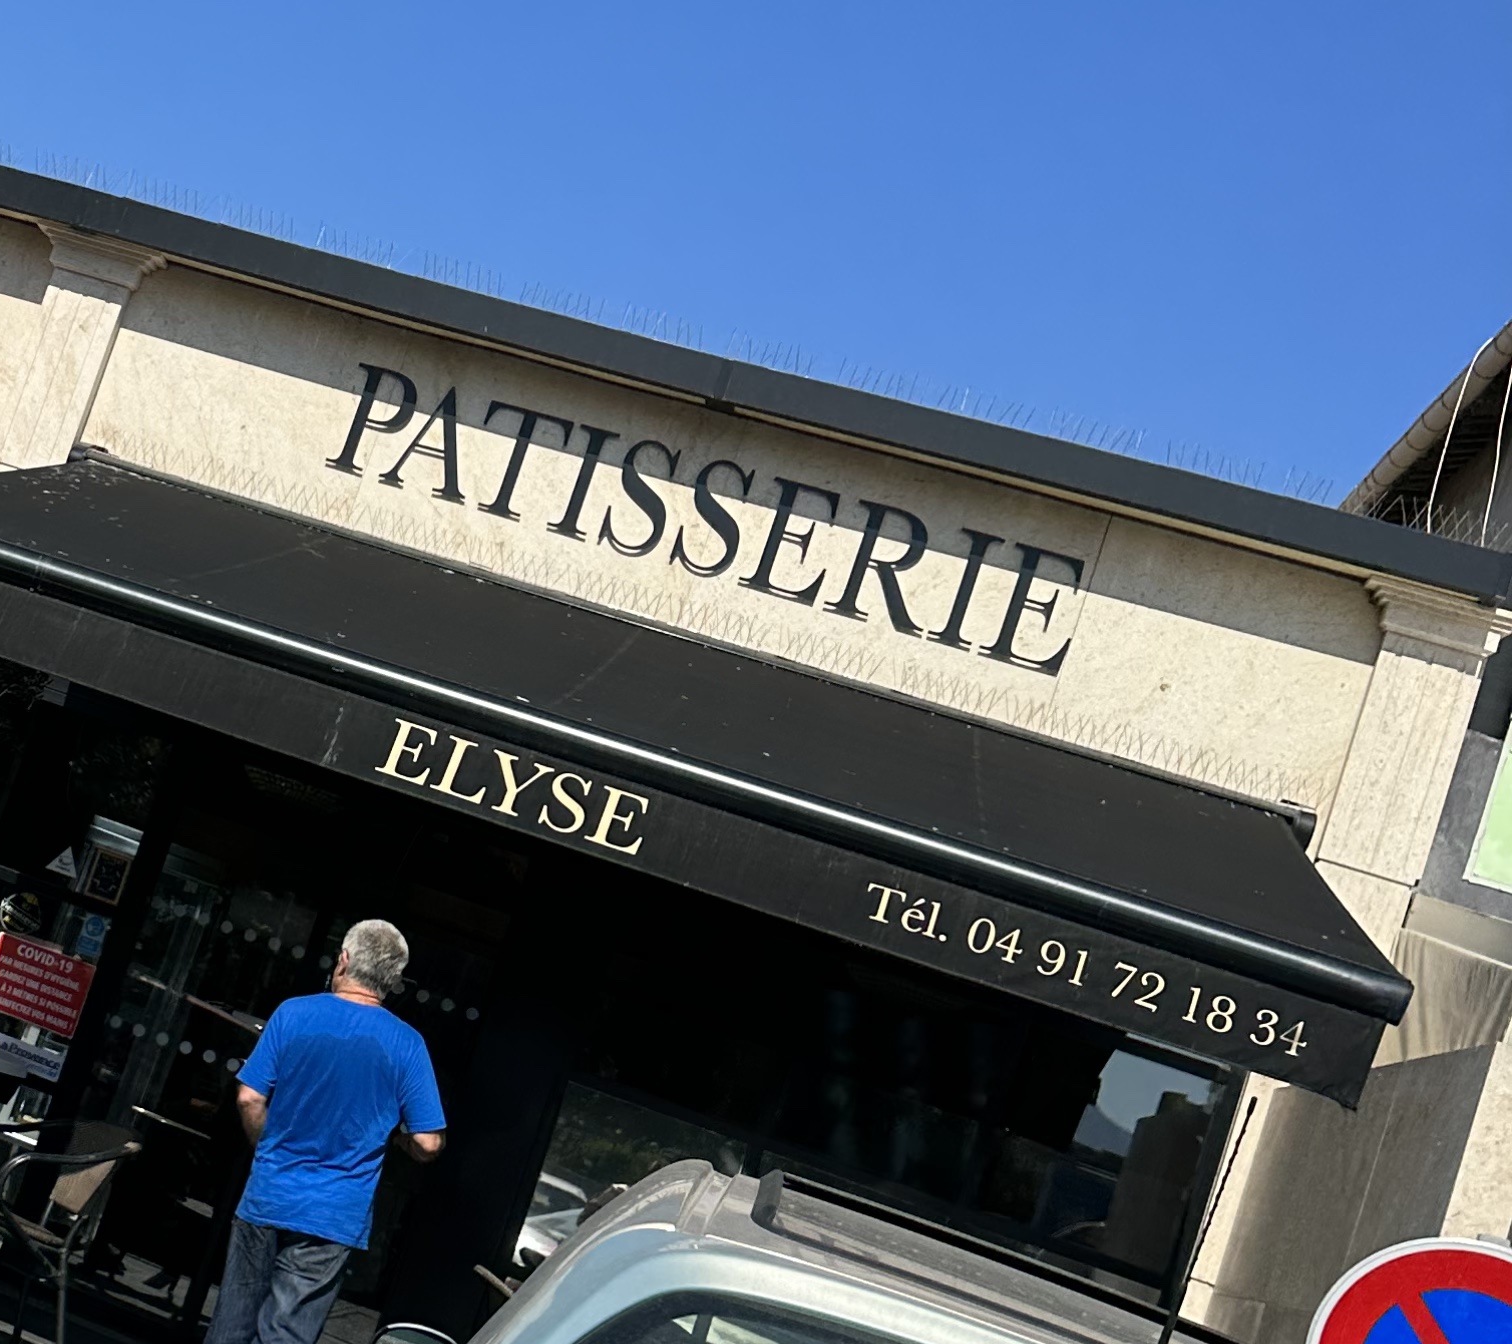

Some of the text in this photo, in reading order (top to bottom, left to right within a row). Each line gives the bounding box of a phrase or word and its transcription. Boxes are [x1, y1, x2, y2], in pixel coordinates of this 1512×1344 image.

[325, 362, 1086, 676] PATISSERIE
[374, 718, 650, 856] ELYSE
[0, 954, 13, 966] PAR
[17, 944, 74, 974] COVID-19
[867, 882, 1307, 1056] Tél. 04 91 72 18 34
[7, 984, 12, 995] 2
[46, 997, 79, 1018] POSSIBLE
[40, 982, 73, 1002] DISTANCE
[8, 1042, 61, 1070] Provence
